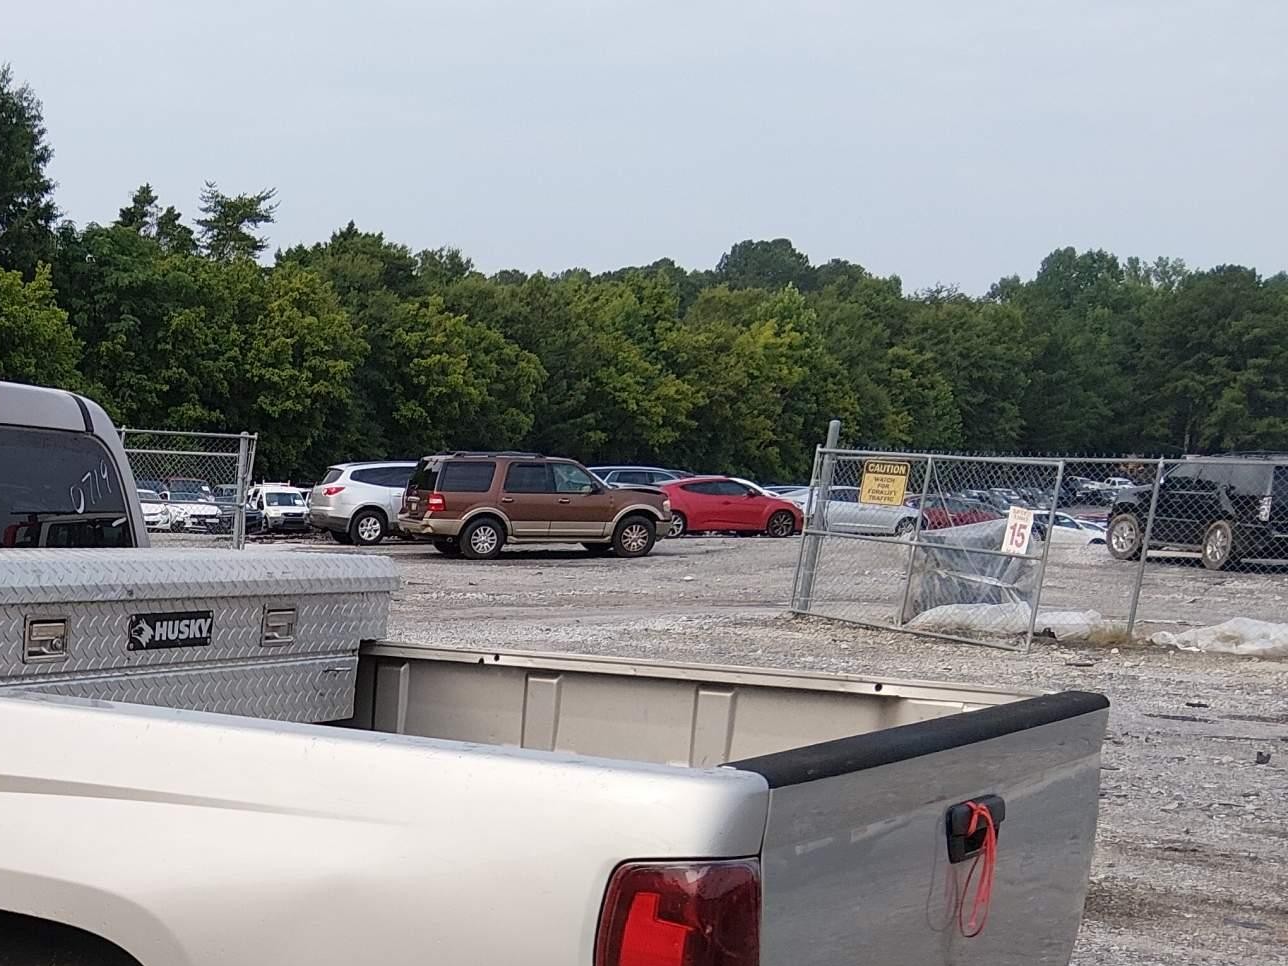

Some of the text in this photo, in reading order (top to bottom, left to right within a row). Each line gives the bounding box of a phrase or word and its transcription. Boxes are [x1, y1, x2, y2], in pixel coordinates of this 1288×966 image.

[868, 463, 907, 475] CAUTION
[70, 459, 113, 514] 0719
[868, 494, 896, 502] TRAFFIC
[1009, 523, 1028, 548] 15
[154, 618, 212, 641] HUSKY
